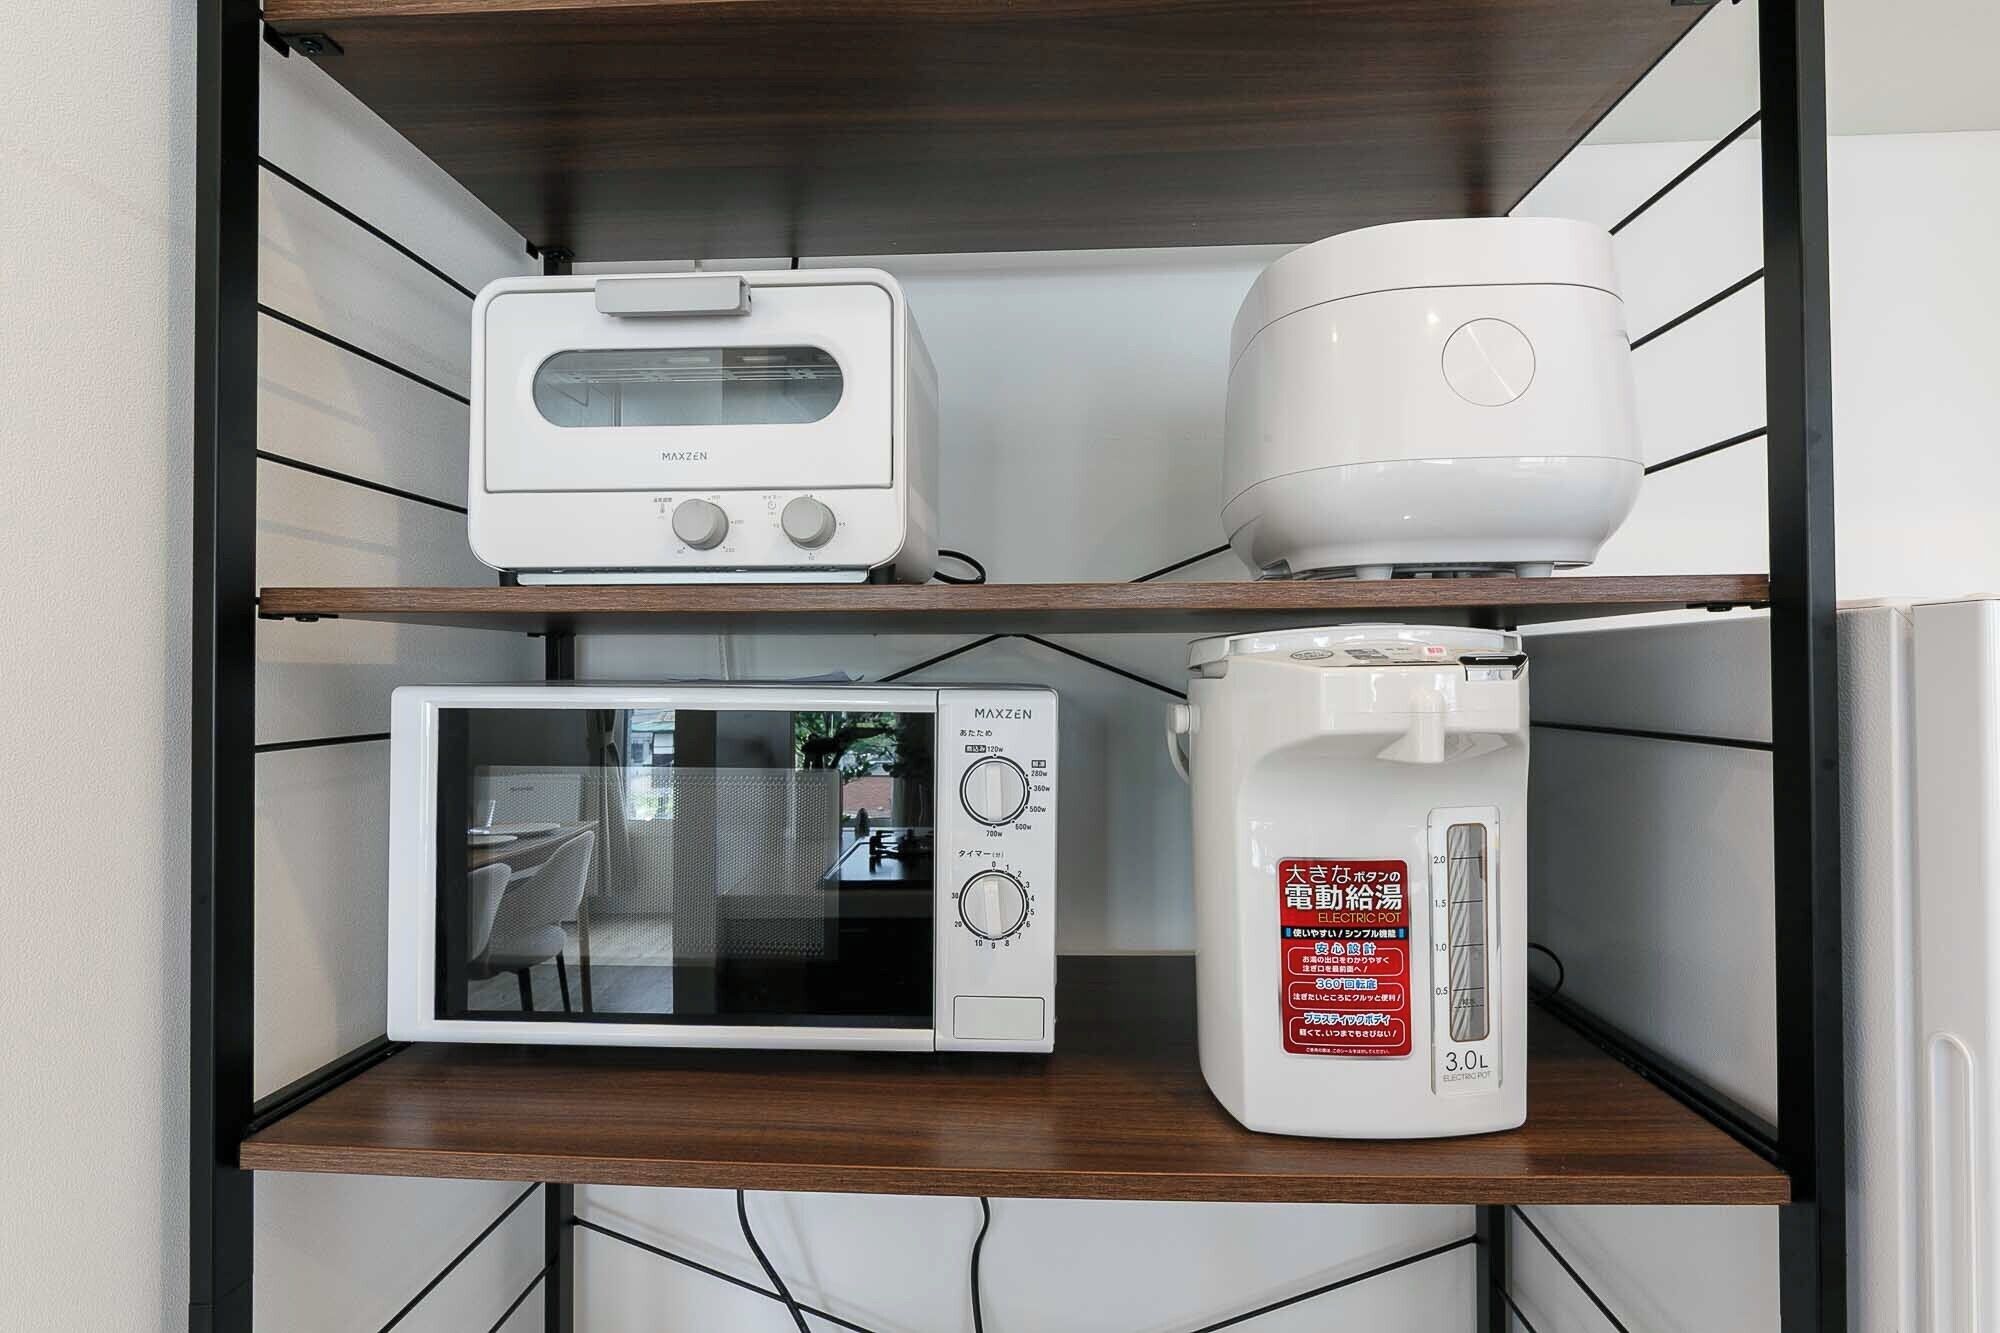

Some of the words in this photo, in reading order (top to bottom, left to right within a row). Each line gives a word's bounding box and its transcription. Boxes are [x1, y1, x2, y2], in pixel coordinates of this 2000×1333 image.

[662, 452, 707, 461] MAXZEN
[975, 708, 1032, 719] MAXZEN
[960, 729, 992, 737] あたため
[1433, 855, 1446, 864] 2.0
[1285, 864, 1401, 884] 大きなボタンの
[1025, 881, 1030, 889] 3
[1284, 883, 1403, 911] 電動給湯
[1434, 899, 1447, 908] 1.5
[1030, 908, 1035, 916] 5
[1318, 912, 1377, 923] ELECTRIC
[1378, 912, 1401, 923] POT
[975, 939, 983, 947] 10
[1435, 943, 1447, 952] 1.0
[1315, 942, 1377, 955] 安心設計
[1435, 987, 1448, 996] 0.5
